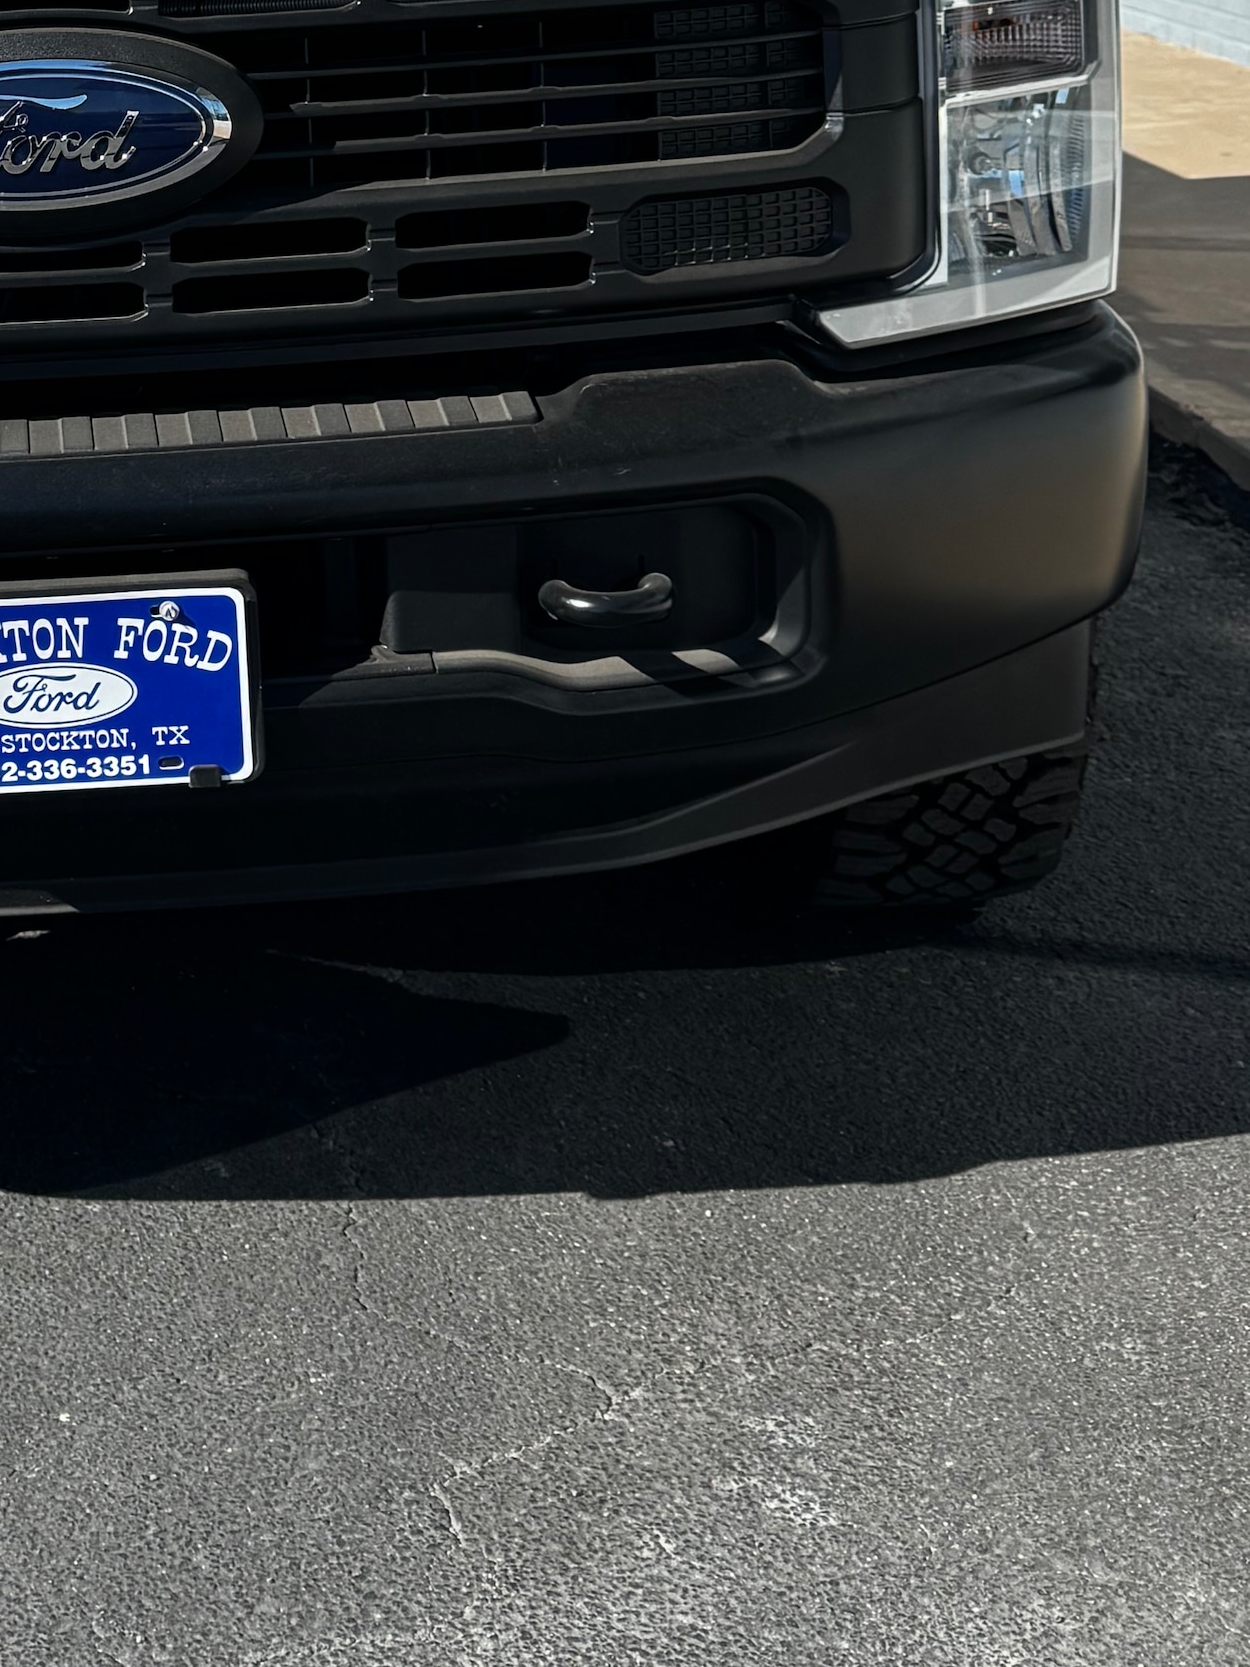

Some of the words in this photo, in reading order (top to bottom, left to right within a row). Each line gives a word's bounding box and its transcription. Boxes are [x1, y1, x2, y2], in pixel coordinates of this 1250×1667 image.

[113, 617, 233, 672] FORD
[2, 673, 101, 715] Ford
[0, 727, 138, 754] STOCKTON,
[151, 725, 191, 746] TX
